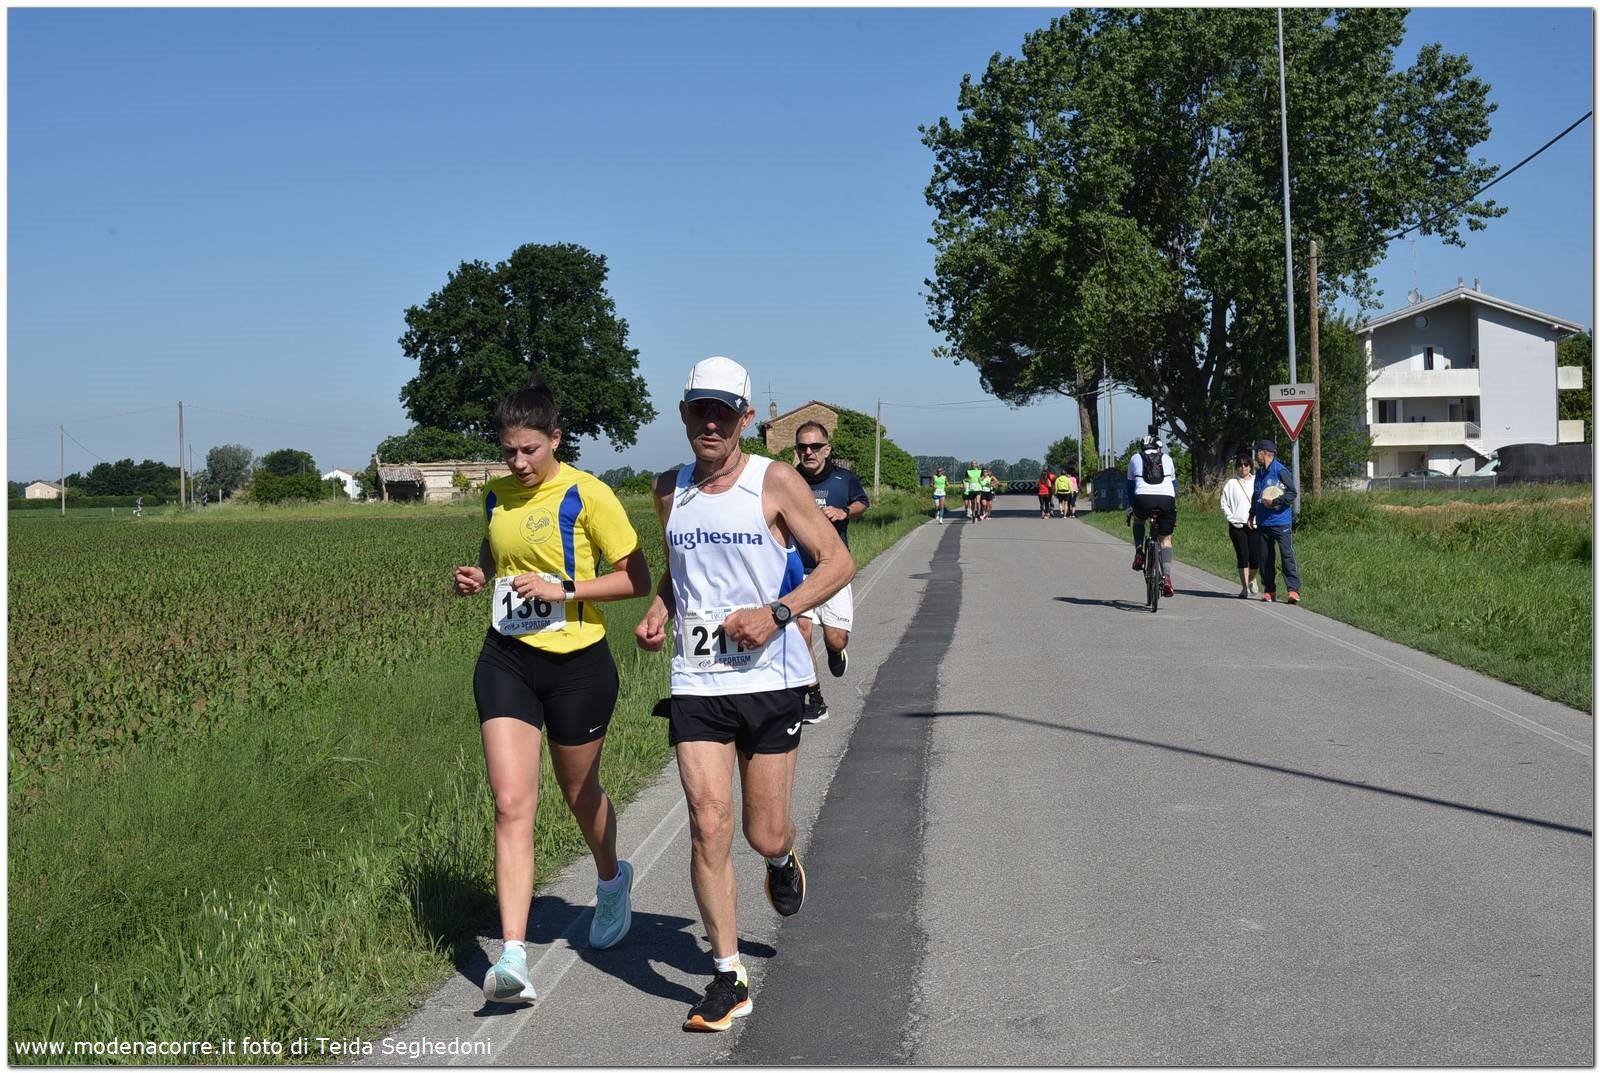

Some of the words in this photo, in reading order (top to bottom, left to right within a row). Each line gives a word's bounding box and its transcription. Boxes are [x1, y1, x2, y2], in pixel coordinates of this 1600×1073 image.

[1280, 388, 1296, 396] 150
[669, 527, 763, 550] lughesina
[502, 591, 552, 620] 136
